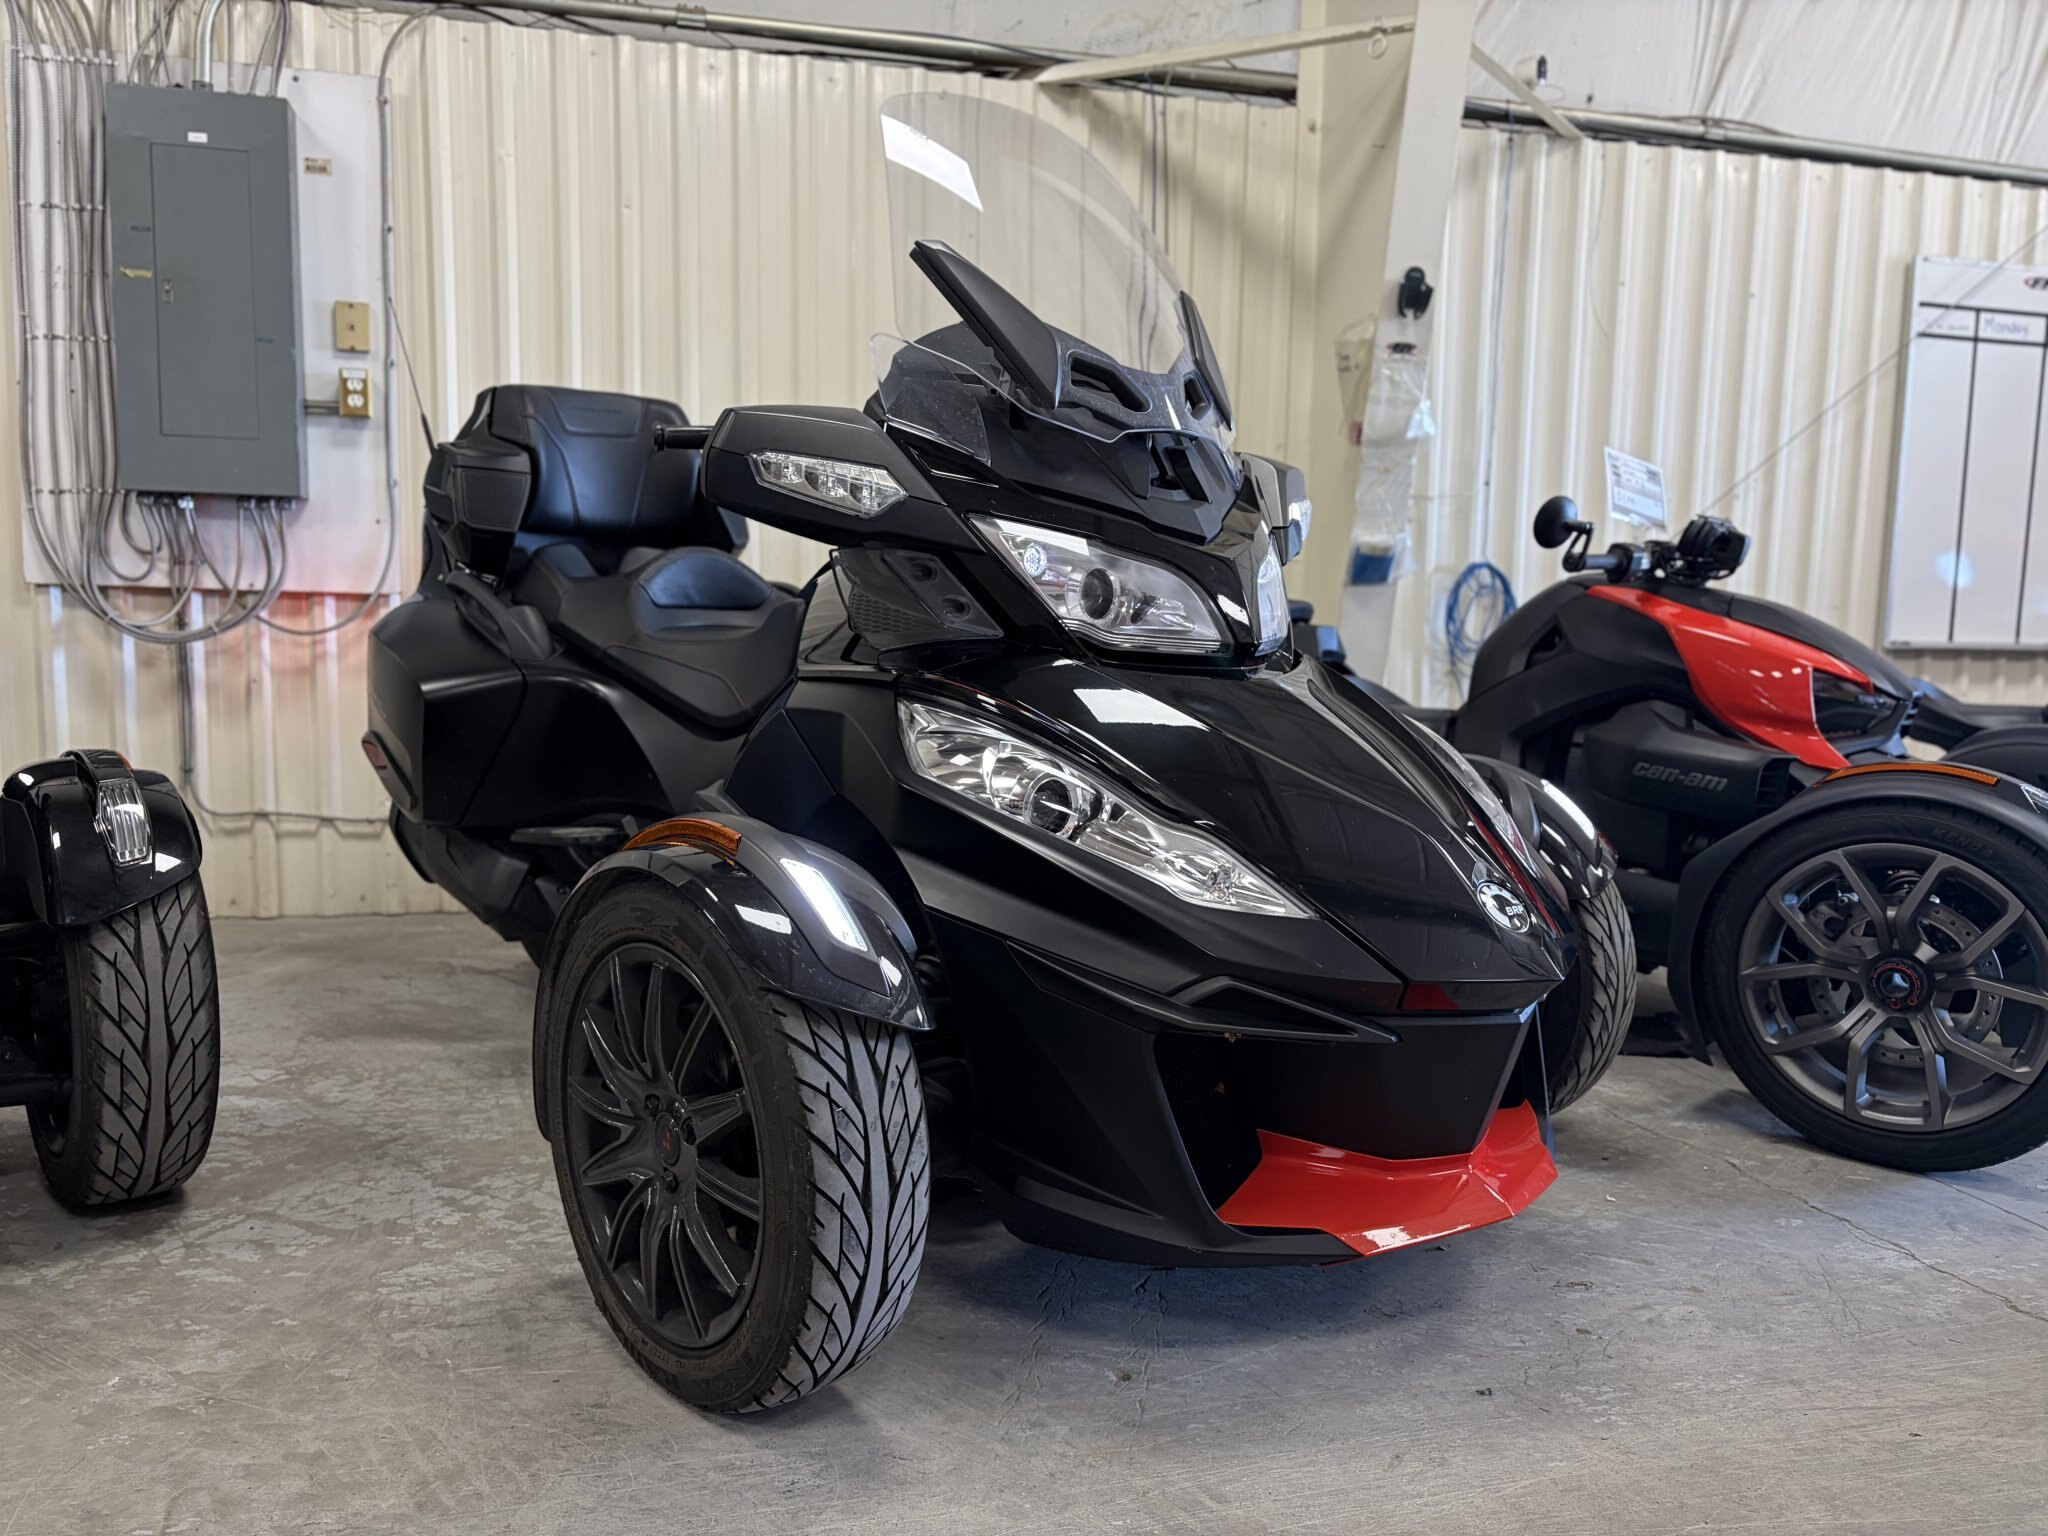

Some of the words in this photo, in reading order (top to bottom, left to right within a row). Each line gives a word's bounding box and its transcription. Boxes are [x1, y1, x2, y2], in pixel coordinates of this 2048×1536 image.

[1632, 762, 1728, 791] can-am
[1930, 828, 1993, 858] KENDA
[1505, 906, 1524, 916] BRP
